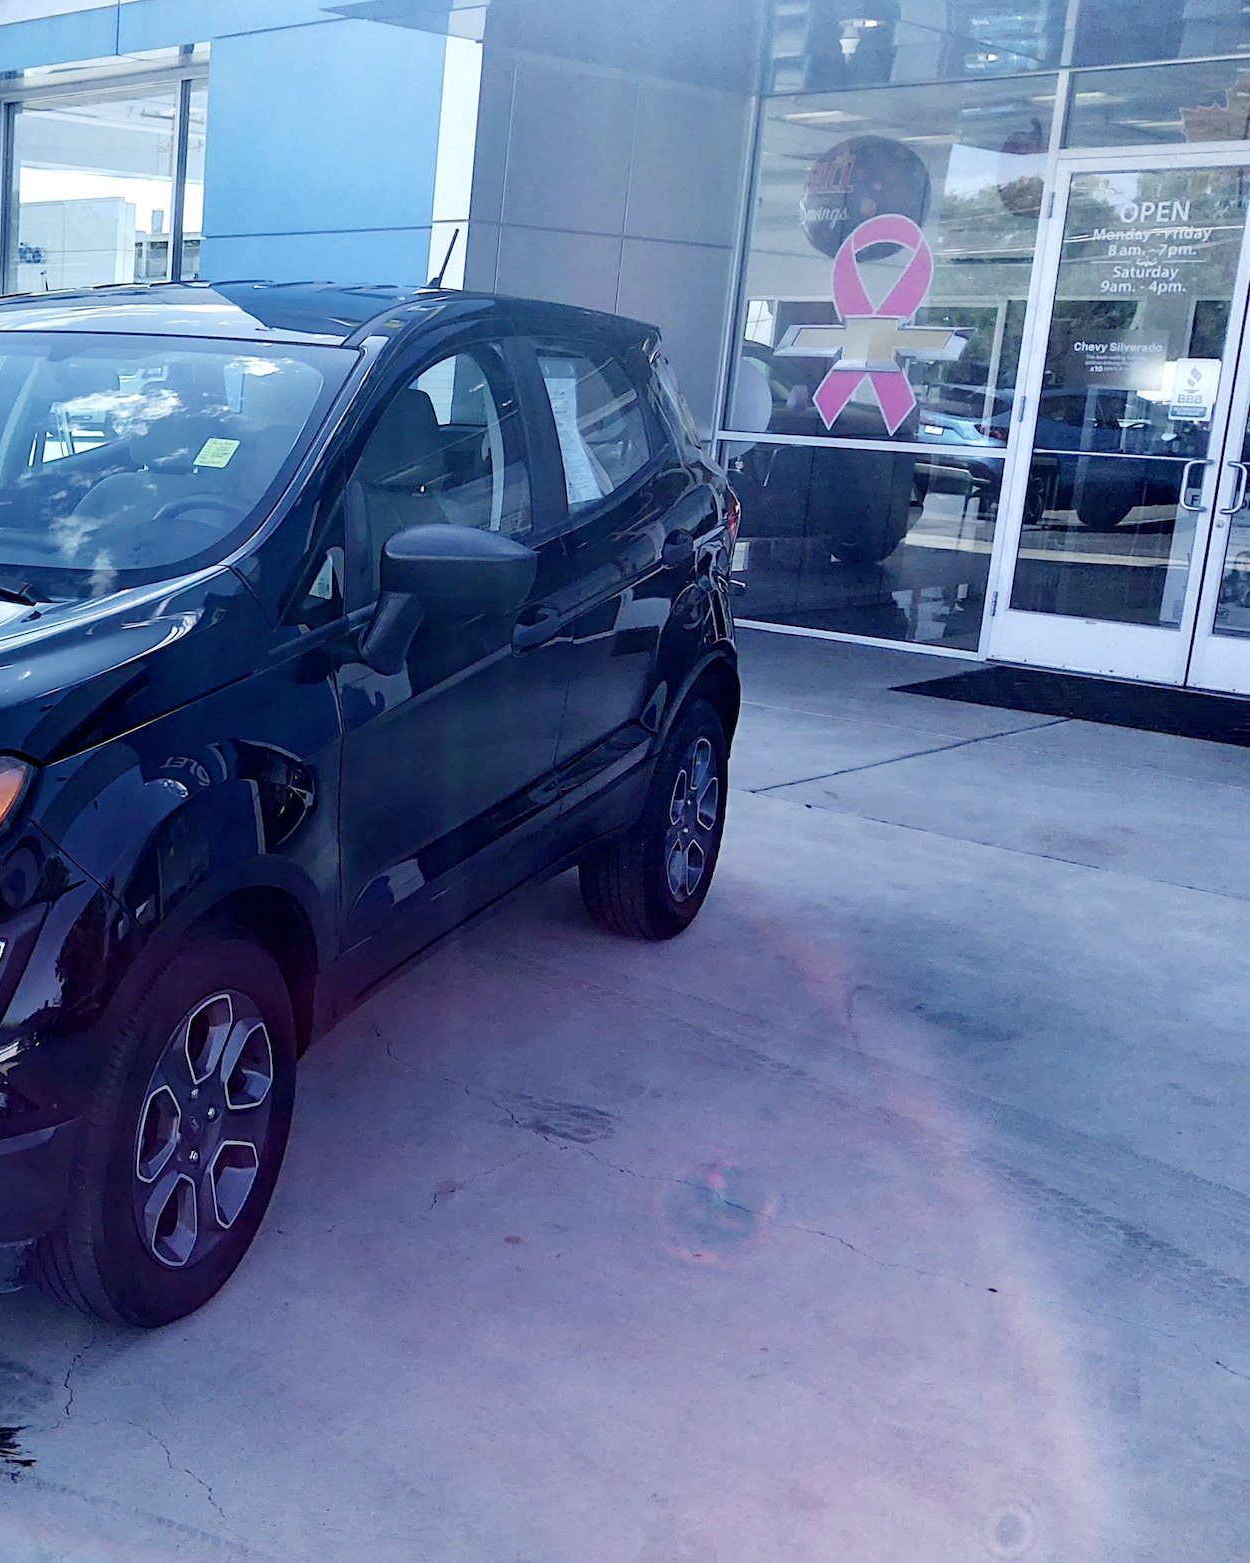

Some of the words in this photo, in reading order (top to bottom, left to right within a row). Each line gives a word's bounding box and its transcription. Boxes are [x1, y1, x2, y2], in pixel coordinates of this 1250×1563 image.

[1120, 200, 1191, 223] OPEN
[1092, 228, 1151, 242] Monday
[1164, 226, 1213, 242] Friday
[1158, 244, 1197, 258] 7pm.
[1112, 265, 1179, 281] Saturday
[1100, 280, 1136, 292] 9am.
[1148, 281, 1187, 295] 4pm.
[1073, 342, 1108, 353] Chevy
[1109, 341, 1163, 352] Silverado
[1089, 365, 1103, 373] x10
[1177, 394, 1203, 404] BBB
